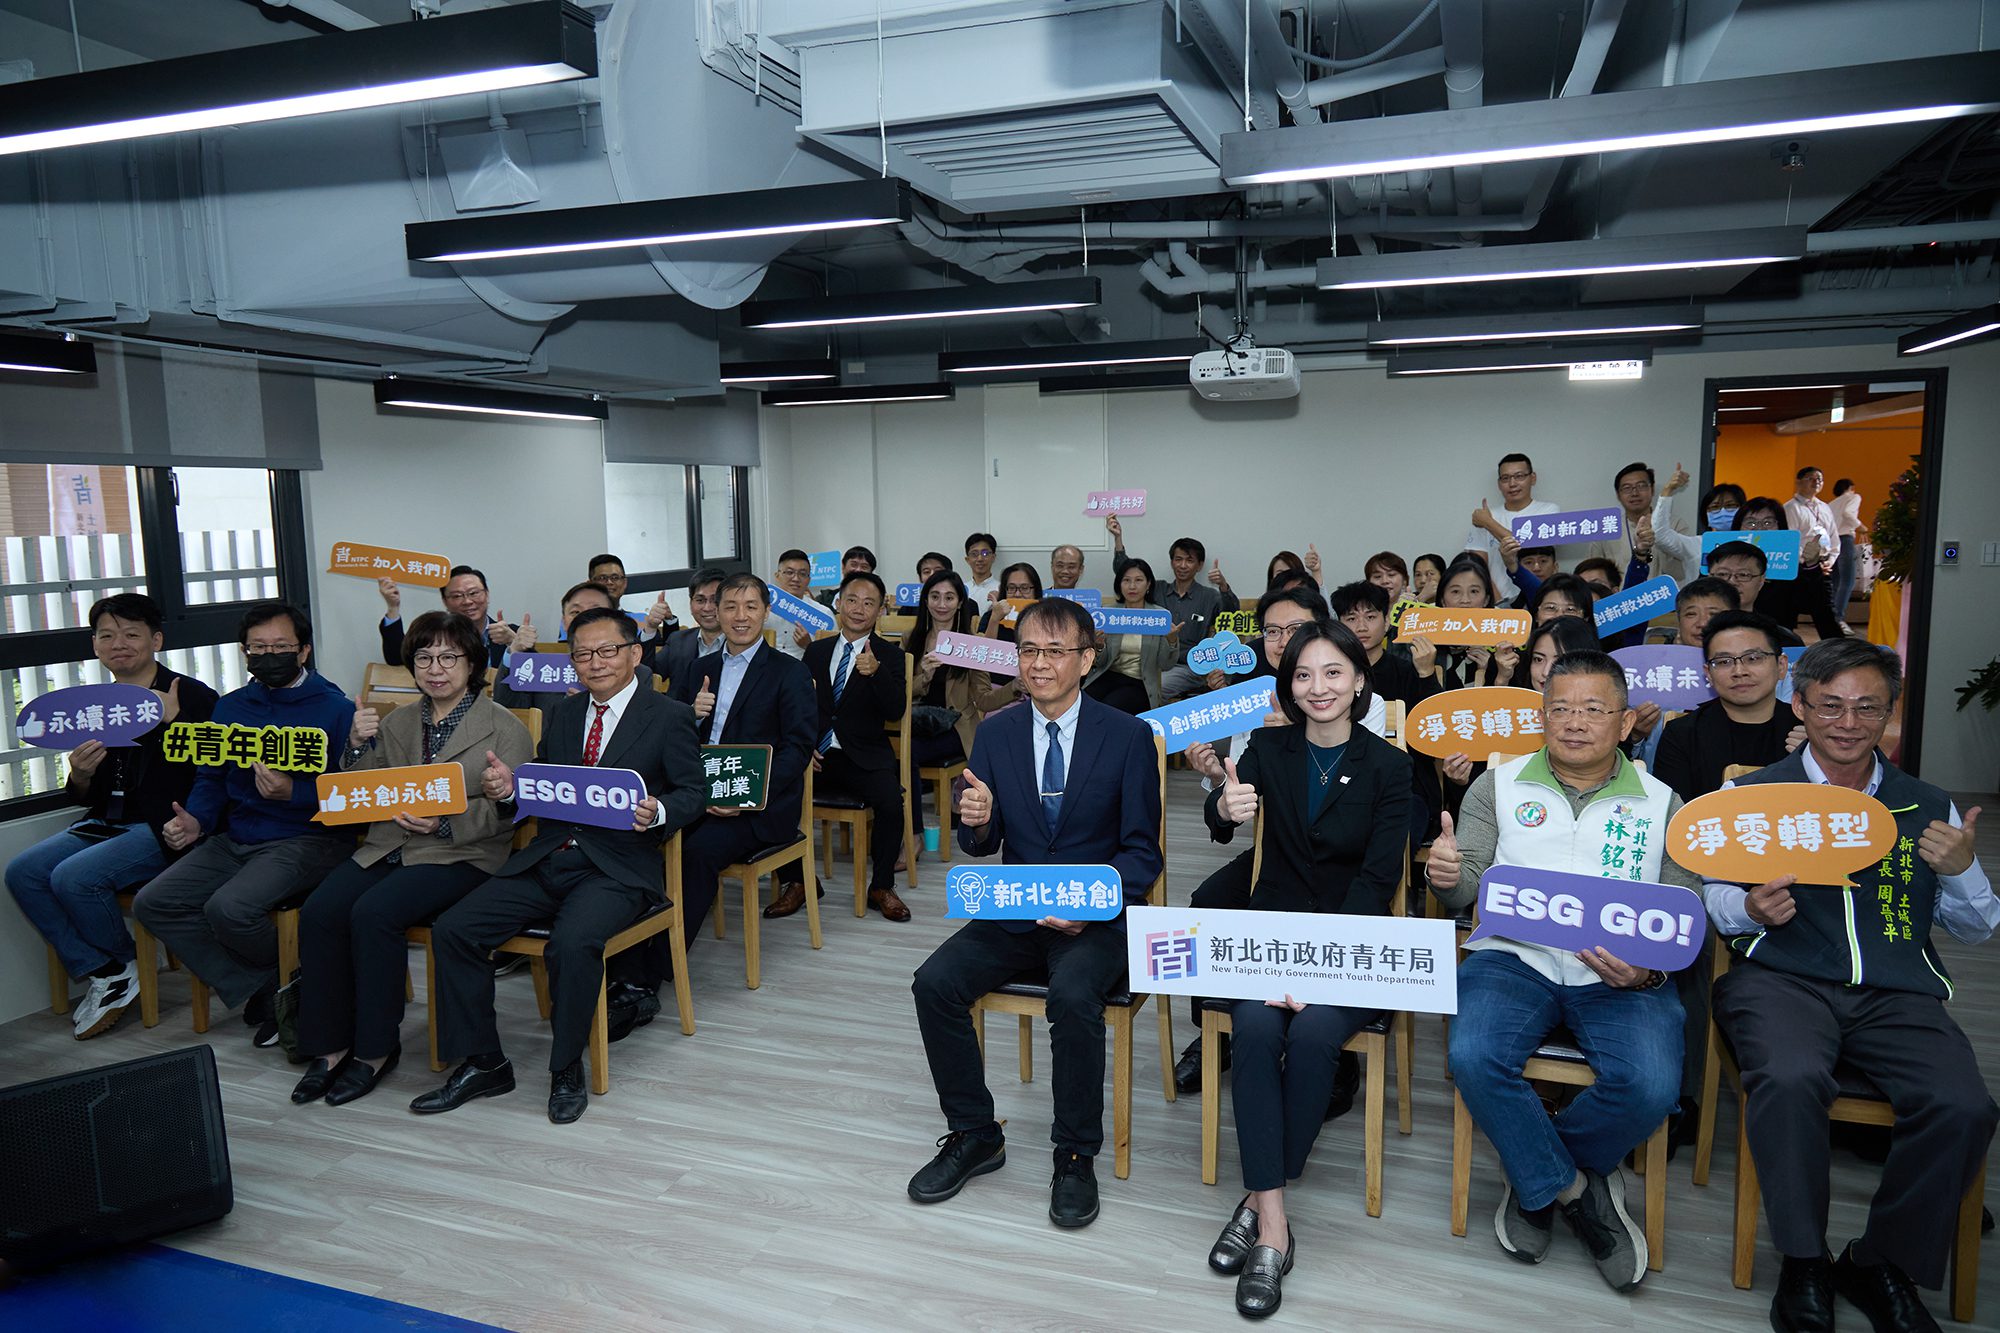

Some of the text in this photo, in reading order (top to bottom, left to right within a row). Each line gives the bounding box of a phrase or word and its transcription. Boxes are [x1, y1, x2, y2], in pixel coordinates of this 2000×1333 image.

[1099, 495, 1144, 510] 永續共好
[1537, 515, 1618, 539] 創新創業
[372, 556, 447, 578] 加入我們!
[777, 598, 829, 631] 創新救地球
[1108, 614, 1167, 627] 創新救地球
[1442, 618, 1527, 634] 加入我們!
[1193, 648, 1219, 664] 夢想
[1225, 651, 1253, 668] 起飛
[49, 700, 160, 734] 永續未來
[1169, 689, 1272, 735] 創新救地球
[167, 726, 323, 768] #青年創業
[703, 755, 743, 777] 青年
[349, 777, 452, 809] 共創永續
[518, 777, 638, 811] ESG GO!
[711, 776, 751, 799] 創業
[1600, 819, 1631, 878] 林銘
[1685, 811, 1872, 856] 淨零轉型
[992, 879, 1119, 909] 新北綠創
[1898, 835, 1915, 940] 新北市 土城區
[1485, 882, 1694, 947] ESG GO!
[1210, 936, 1435, 974] 新北市政府青年局
[1211, 964, 1435, 986] New Taipei City Government Youth Department
